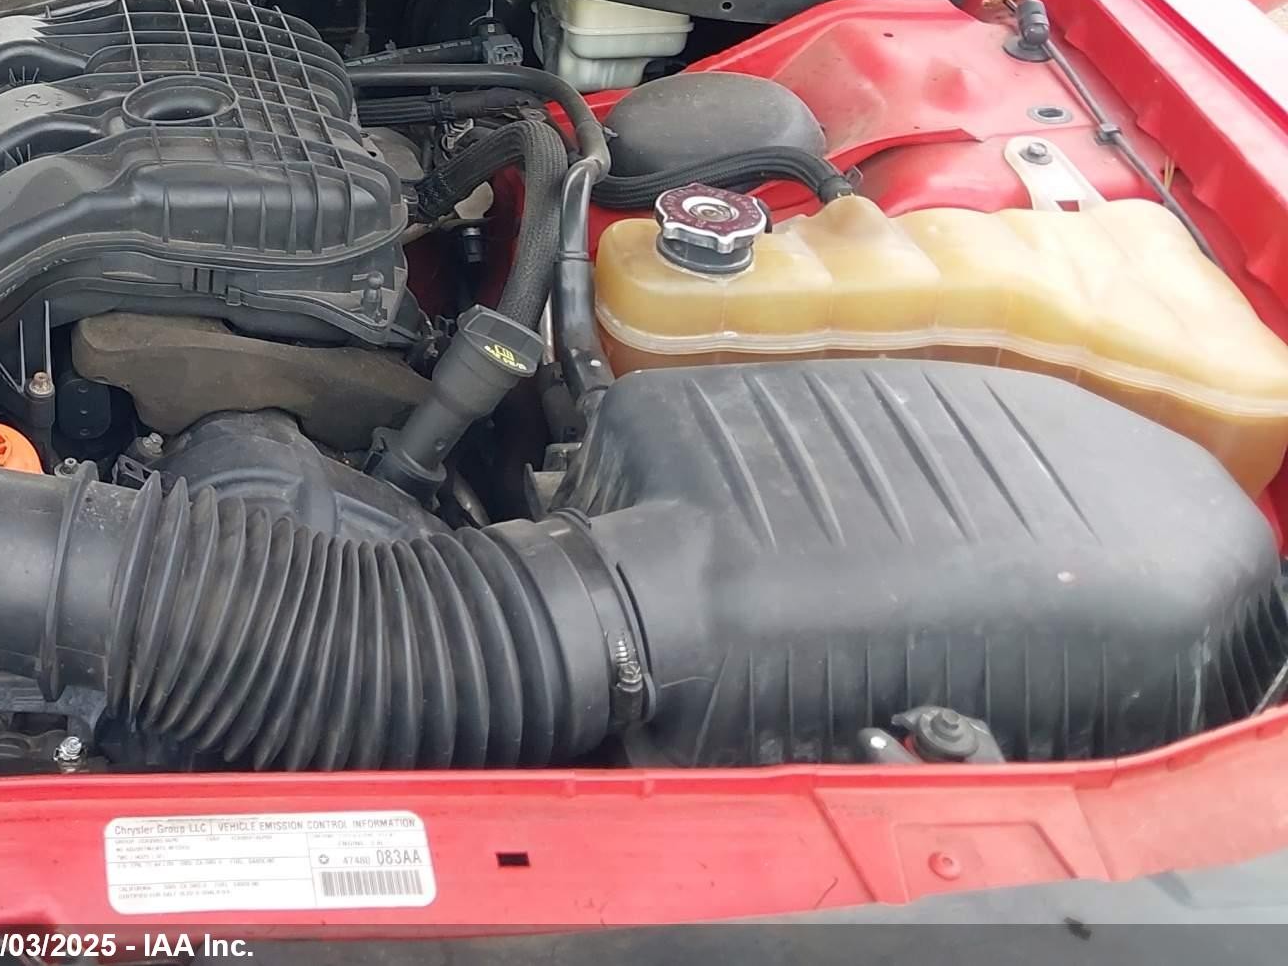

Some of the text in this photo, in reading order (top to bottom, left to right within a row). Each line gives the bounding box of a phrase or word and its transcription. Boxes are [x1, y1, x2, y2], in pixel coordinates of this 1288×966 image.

[114, 823, 207, 836] Chrysler Group LLC
[218, 817, 416, 832] VEHICLE EMISSION CONTROL INFORMATION
[376, 848, 423, 866] 083AA
